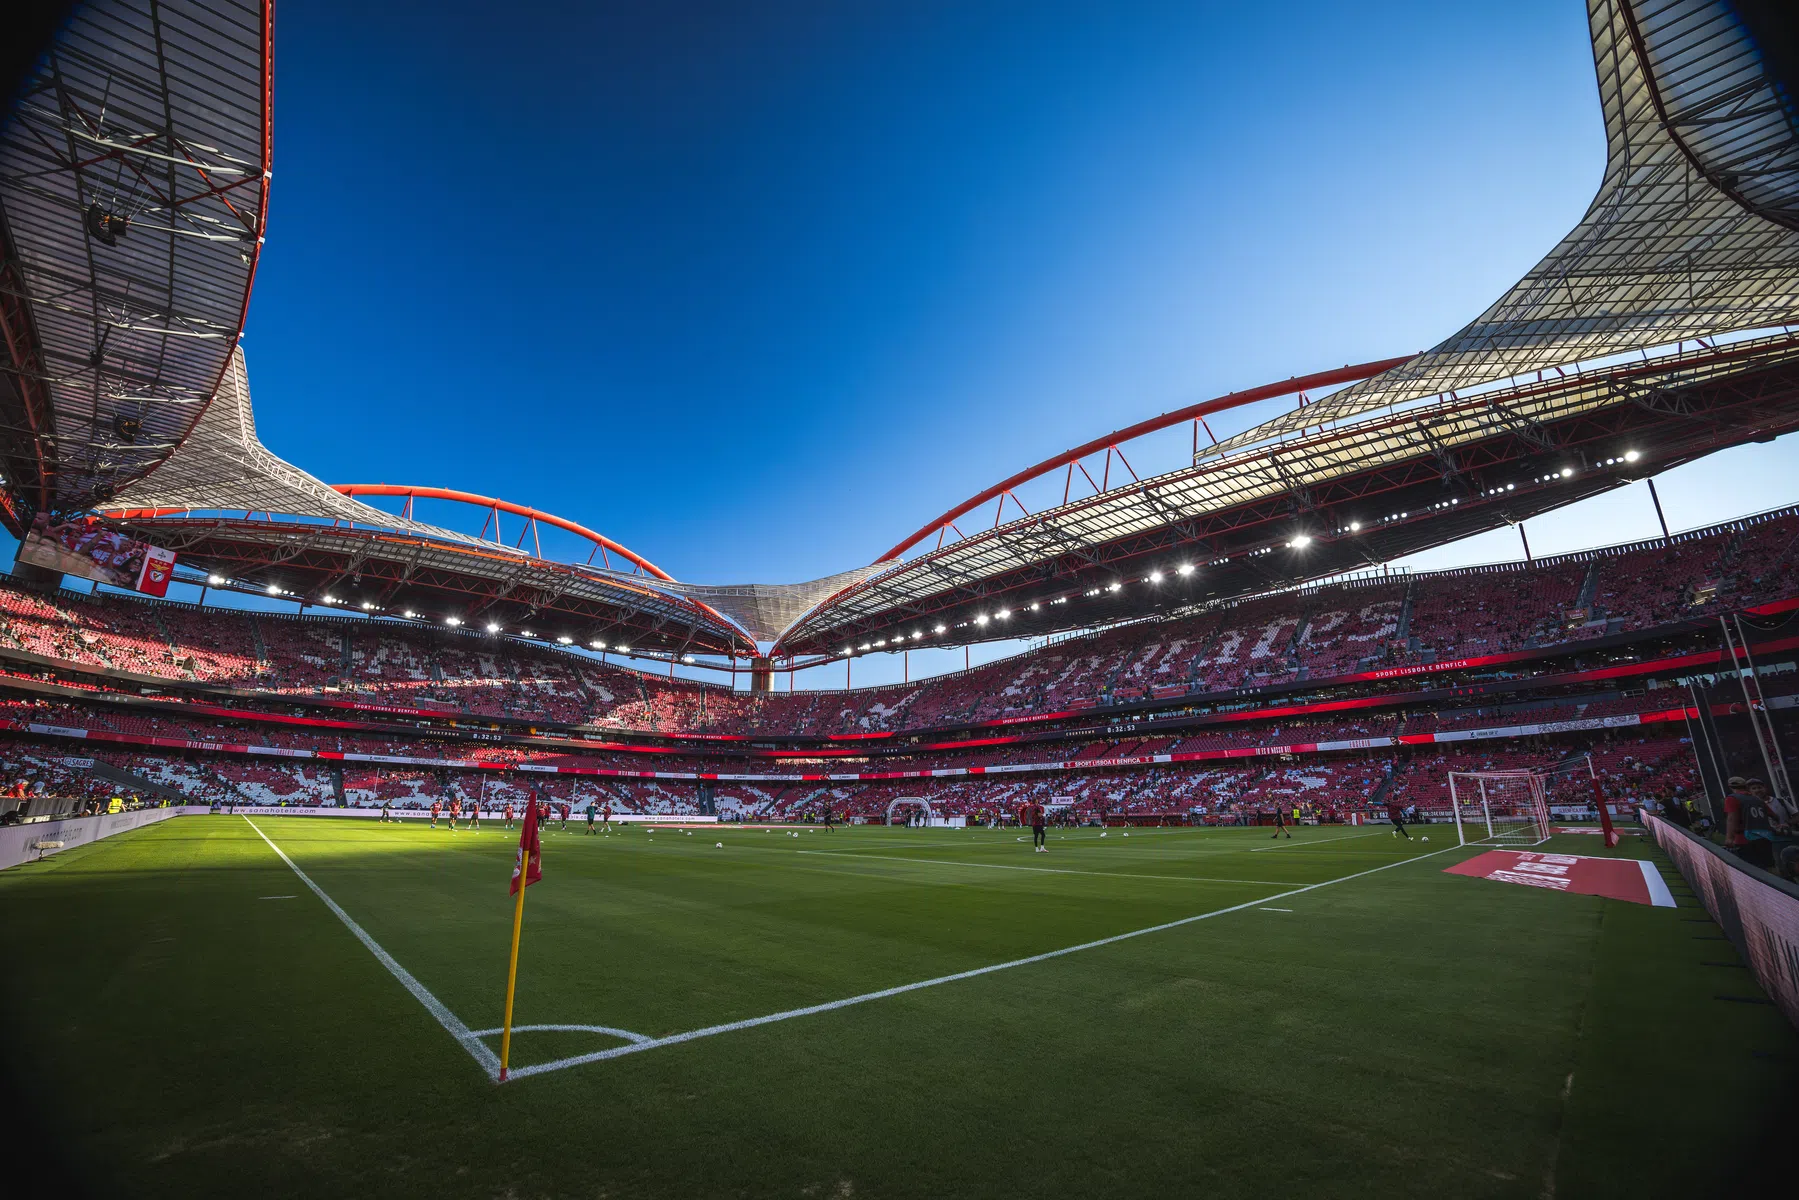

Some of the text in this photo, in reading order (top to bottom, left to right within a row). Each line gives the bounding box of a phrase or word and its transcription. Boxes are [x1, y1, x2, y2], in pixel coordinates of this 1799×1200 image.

[1375, 669, 1398, 678] SPORT
[1400, 666, 1426, 675] LISBOA
[1435, 660, 1468, 670] BENFICA
[1107, 724, 1136, 733] 0:32:53
[472, 733, 502, 741] 0:32:53
[71, 759, 93, 768] SAGRES
[1750, 806, 1764, 818] 06
